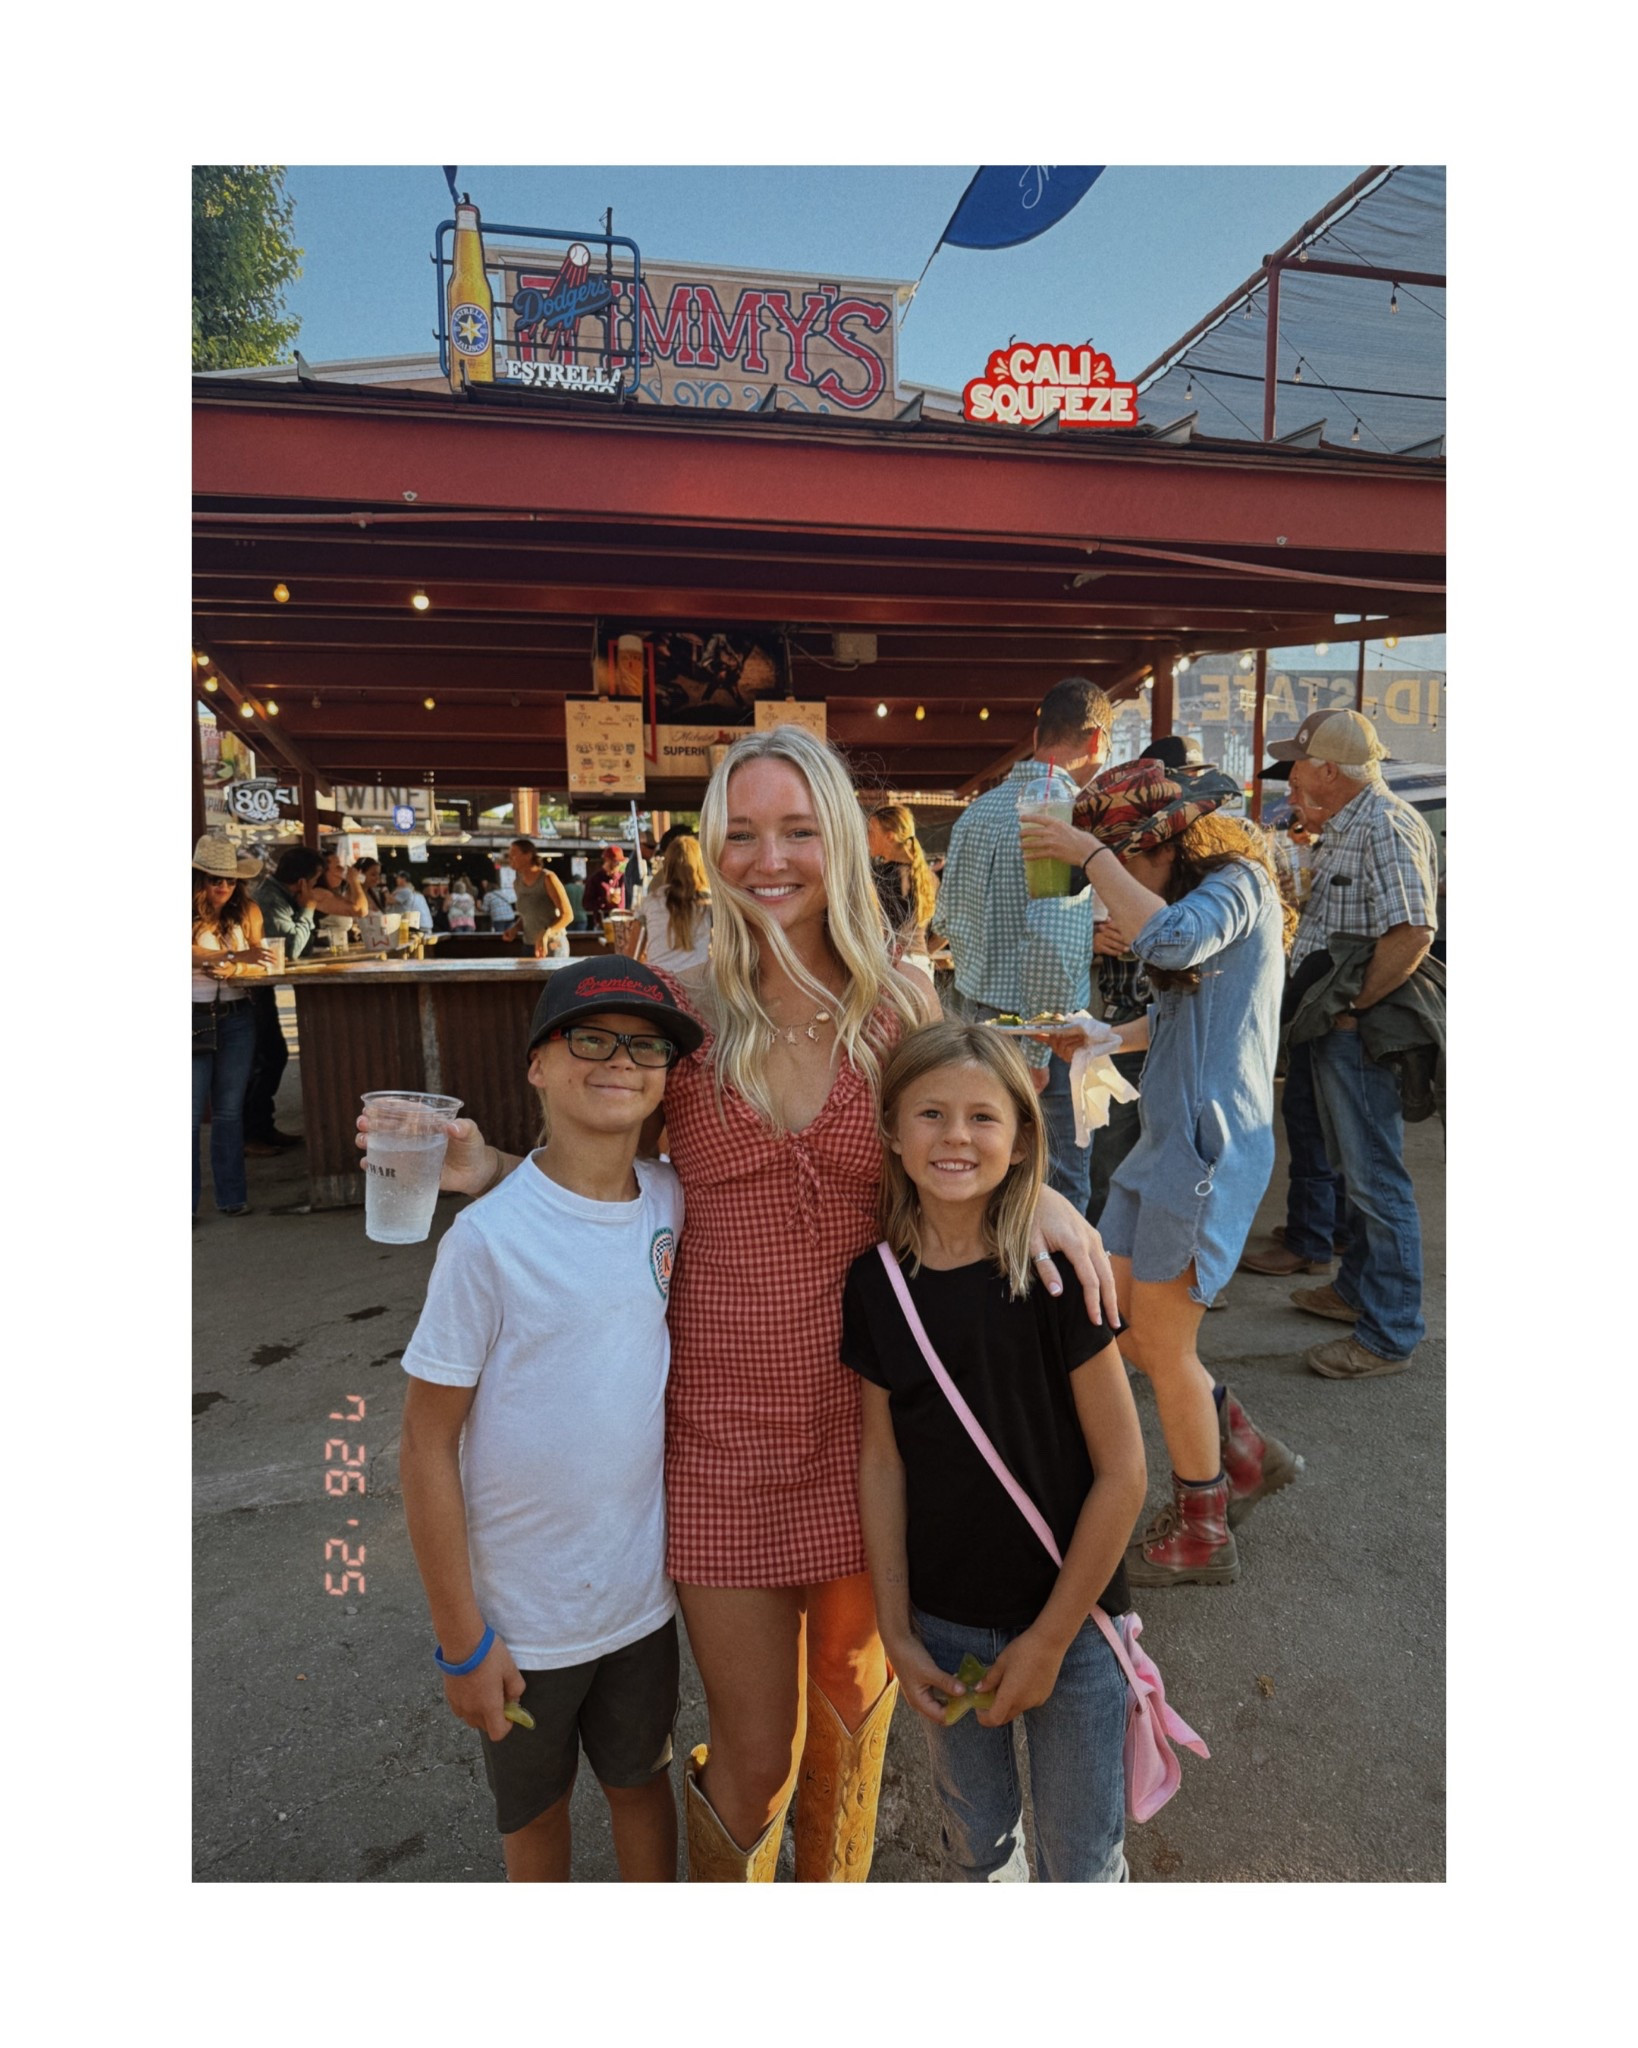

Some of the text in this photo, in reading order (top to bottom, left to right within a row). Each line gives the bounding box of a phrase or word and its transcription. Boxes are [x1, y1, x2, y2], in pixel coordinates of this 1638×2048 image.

[454, 307, 487, 324] ESTRELLA
[514, 277, 611, 330] Dodgers
[456, 339, 486, 352] JALISCO
[506, 360, 622, 387] ESTRELLA
[1009, 348, 1091, 385] CALI
[970, 383, 1134, 424] SQUEEZE
[344, 786, 425, 811] WINE
[576, 976, 642, 994] Premier
